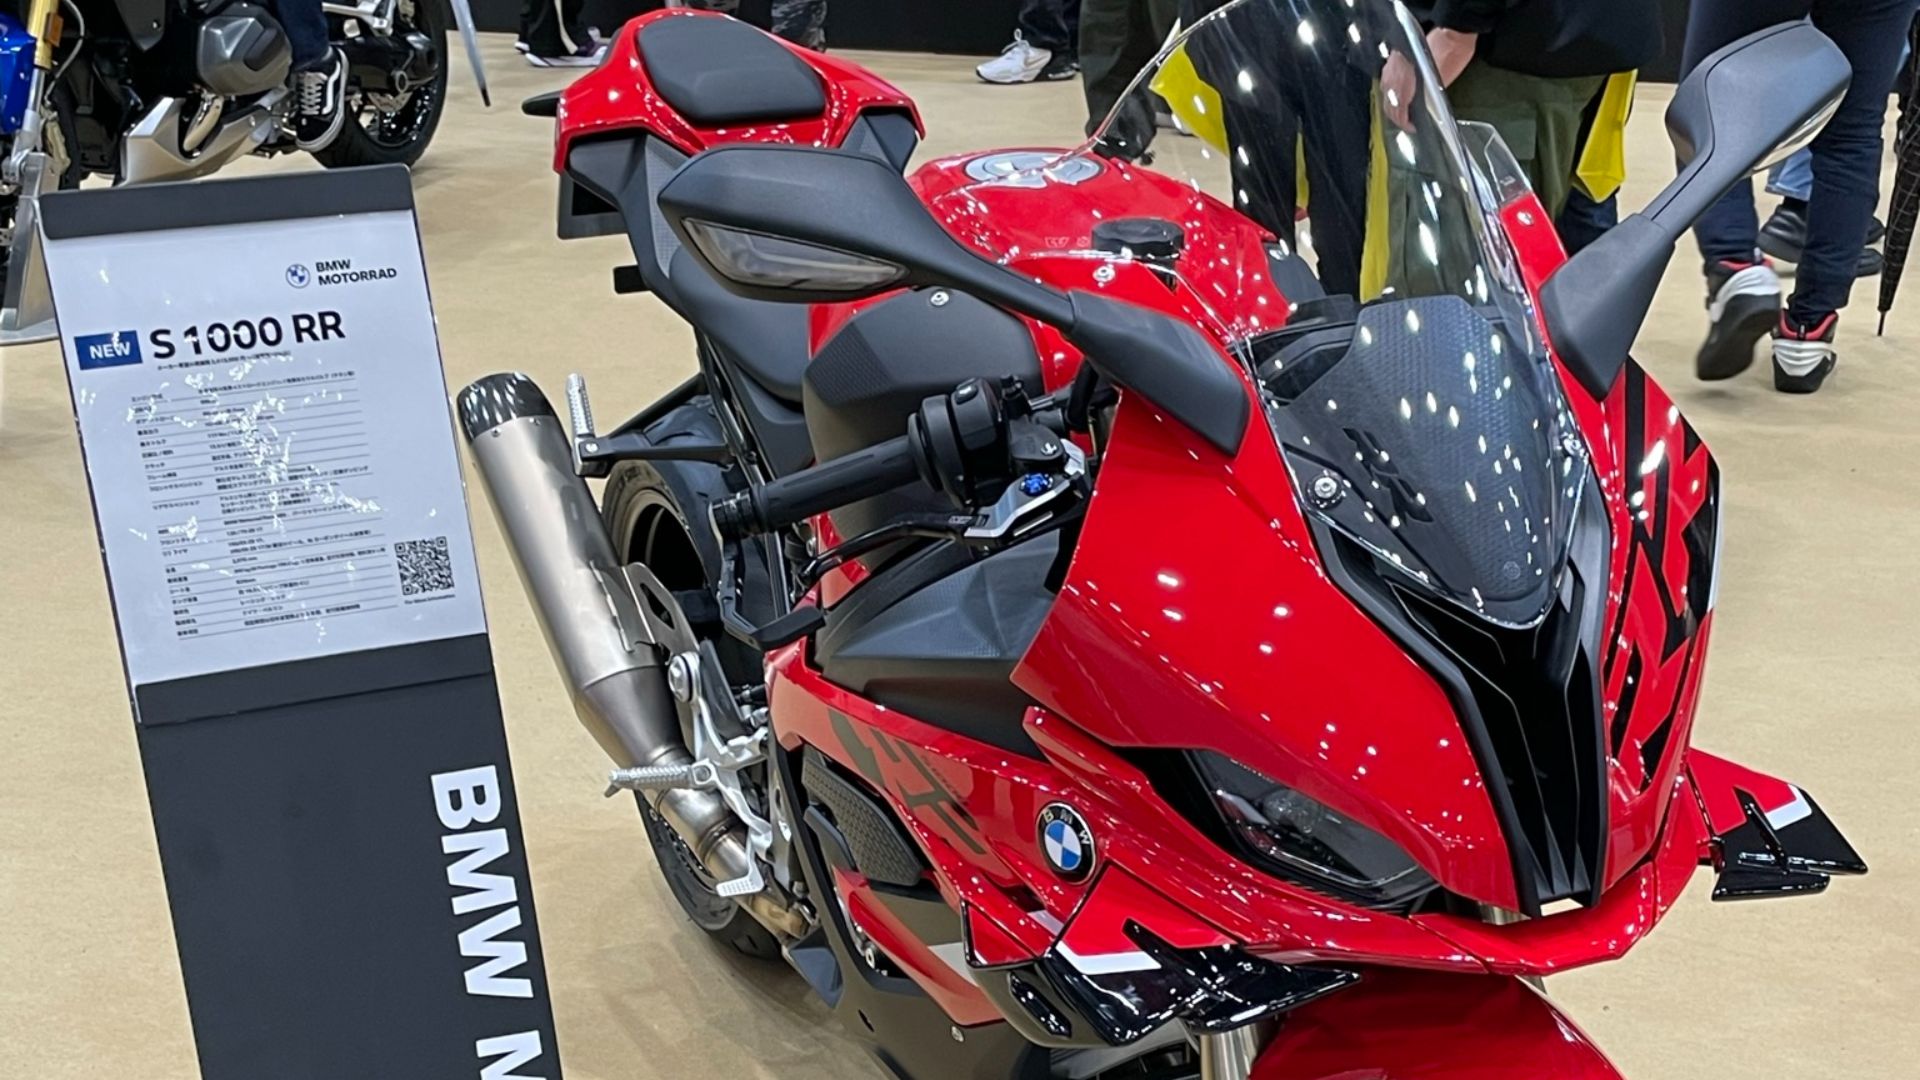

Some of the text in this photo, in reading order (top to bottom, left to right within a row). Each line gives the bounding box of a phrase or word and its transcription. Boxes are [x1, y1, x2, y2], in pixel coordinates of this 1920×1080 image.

[315, 259, 351, 273] BMW
[318, 267, 397, 286] MOTORRAD
[150, 310, 345, 359] S 1000 RR
[89, 341, 131, 360] NEW
[1043, 808, 1091, 845] BMW
[430, 765, 534, 999] BMW
